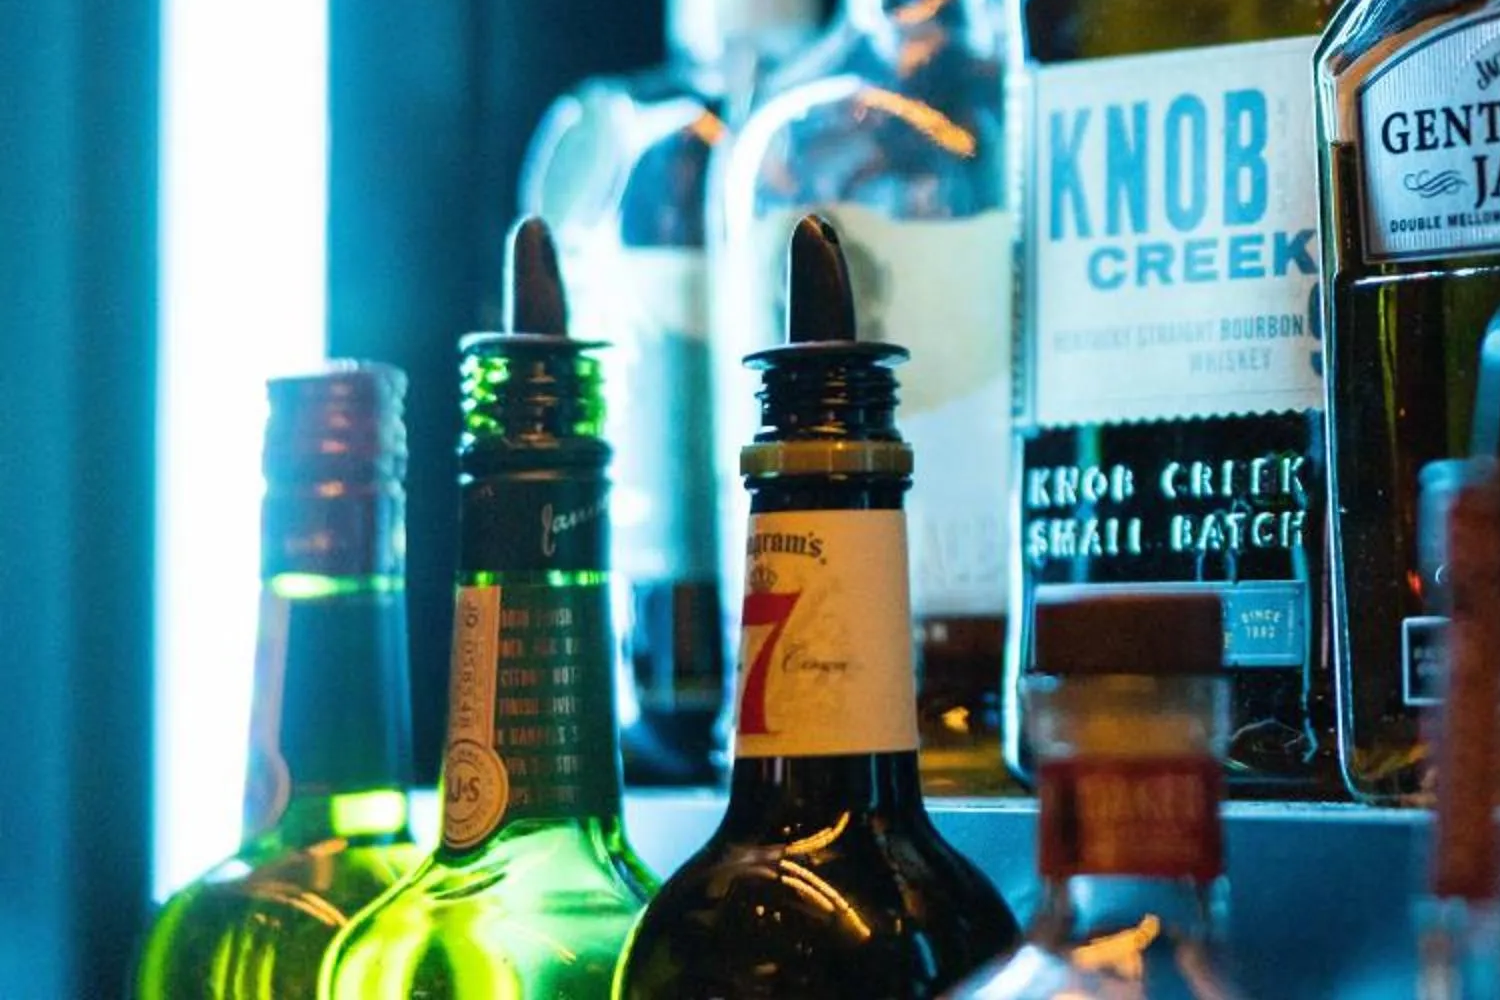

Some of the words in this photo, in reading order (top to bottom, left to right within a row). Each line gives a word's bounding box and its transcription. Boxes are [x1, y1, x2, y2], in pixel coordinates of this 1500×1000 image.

[1049, 87, 1269, 242] KNOB
[1390, 215, 1442, 233] DOUBLE
[1086, 228, 1320, 291] CREEK
[1219, 313, 1304, 342] BOURBON
[1025, 463, 1135, 508] KNOB
[1159, 454, 1306, 498] CREEK
[1025, 516, 1143, 560] SMALL
[1170, 510, 1307, 553] BATCH
[740, 589, 802, 735] 7
